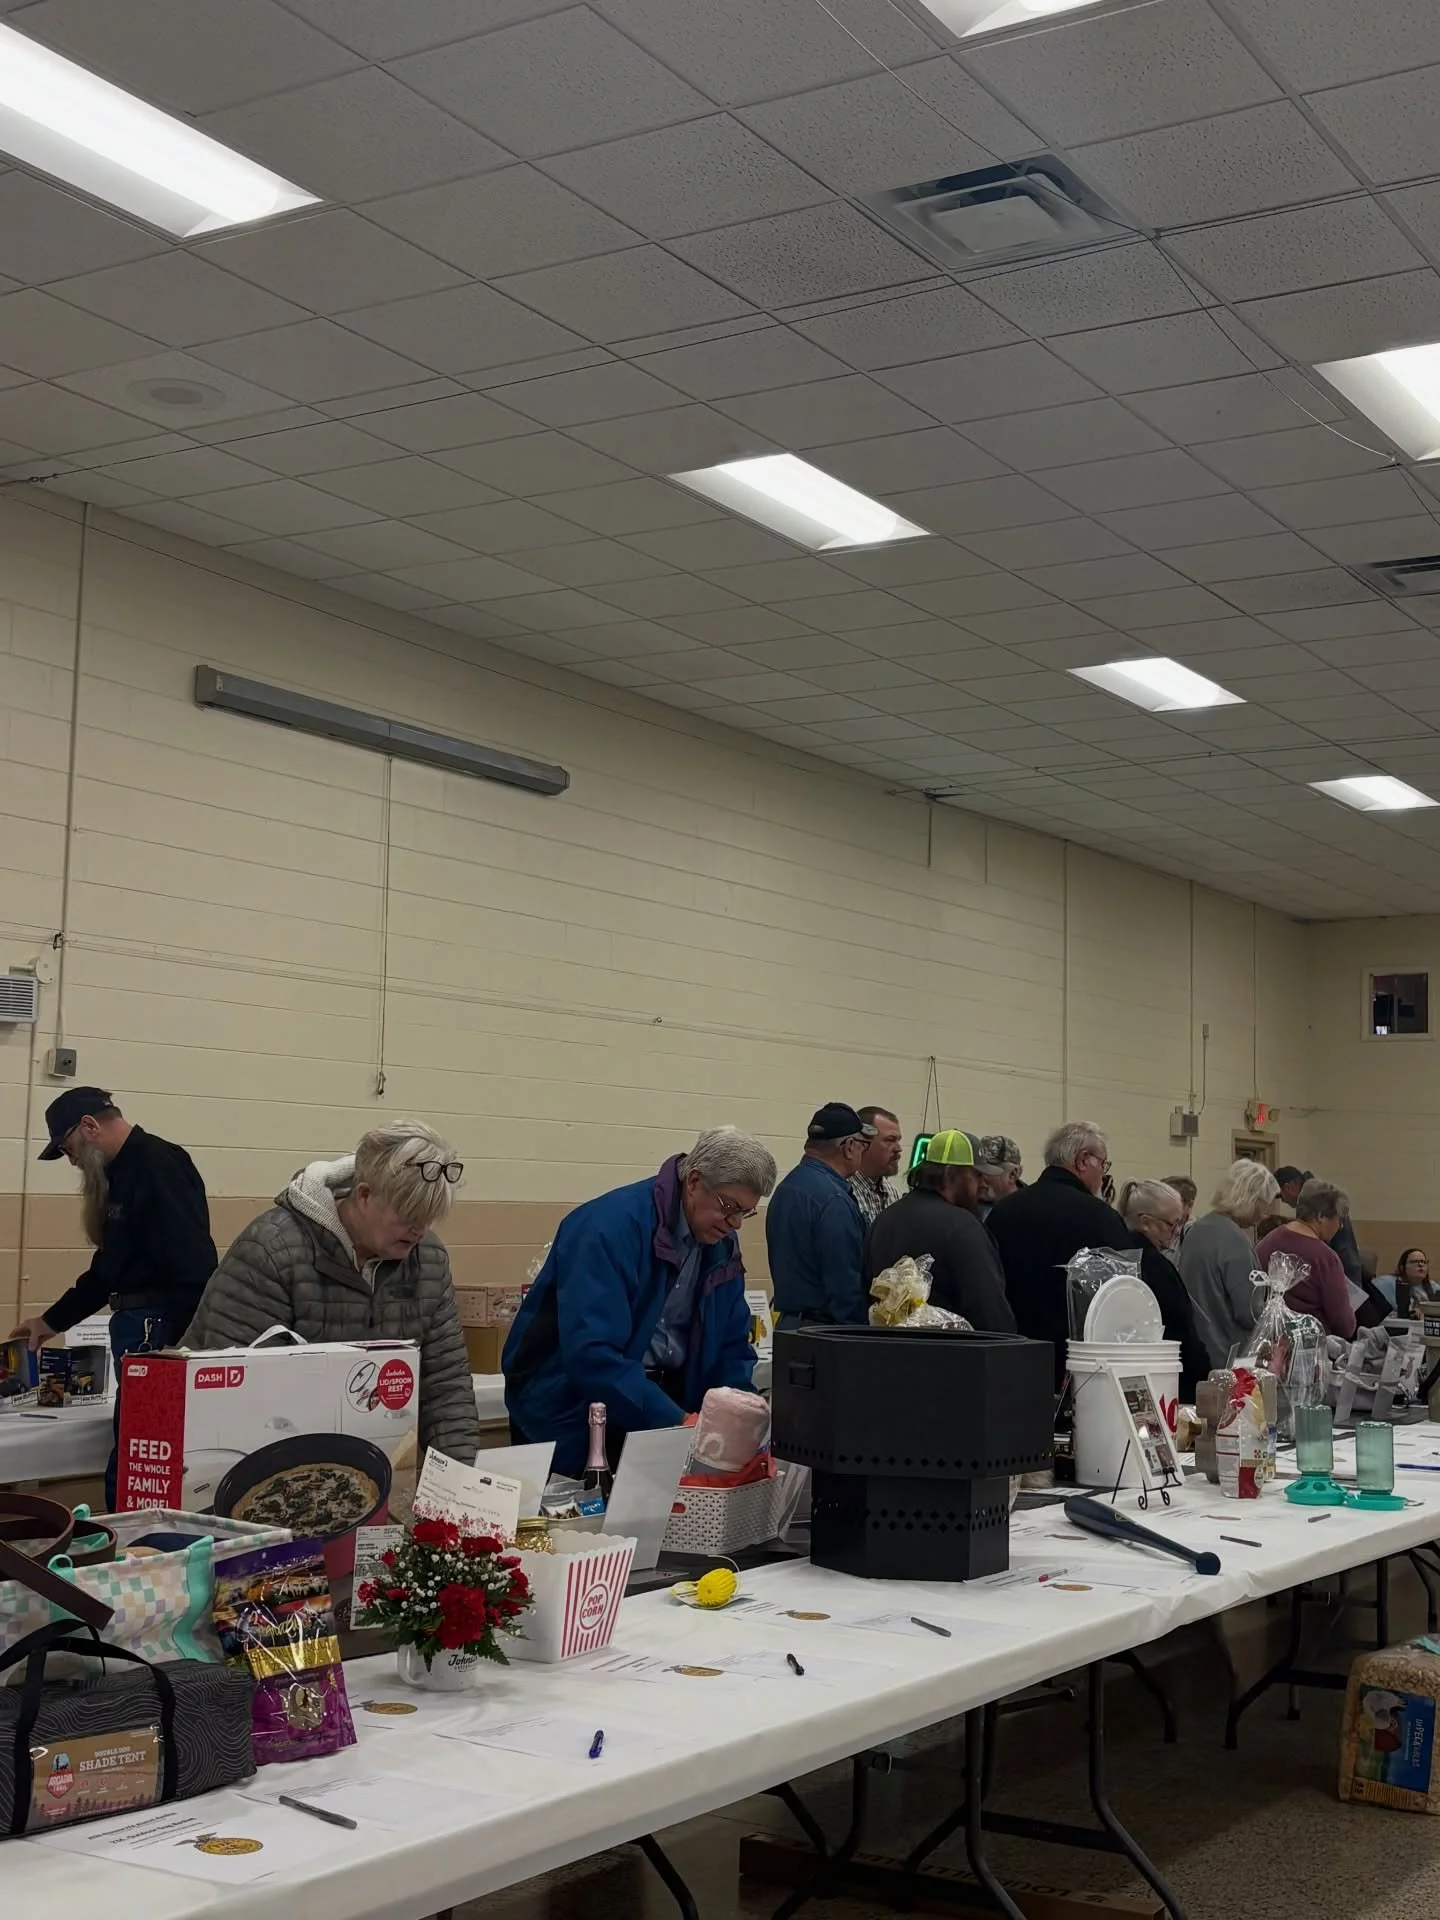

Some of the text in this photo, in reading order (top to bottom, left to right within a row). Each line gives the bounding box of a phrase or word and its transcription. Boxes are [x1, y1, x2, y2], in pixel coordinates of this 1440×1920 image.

[197, 1373, 223, 1383] DASH
[379, 1377, 412, 1386] LID/SPOON
[387, 1384, 404, 1393] REST
[129, 1438, 172, 1461] FEED
[128, 1462, 171, 1475] THE WHOLE
[127, 1476, 171, 1495] FAMILY
[126, 1495, 134, 1509] &
[587, 1594, 604, 1607] POP
[581, 1605, 604, 1618] CORN
[79, 1755, 117, 1772] SHADE
[117, 1751, 147, 1766] TENT
